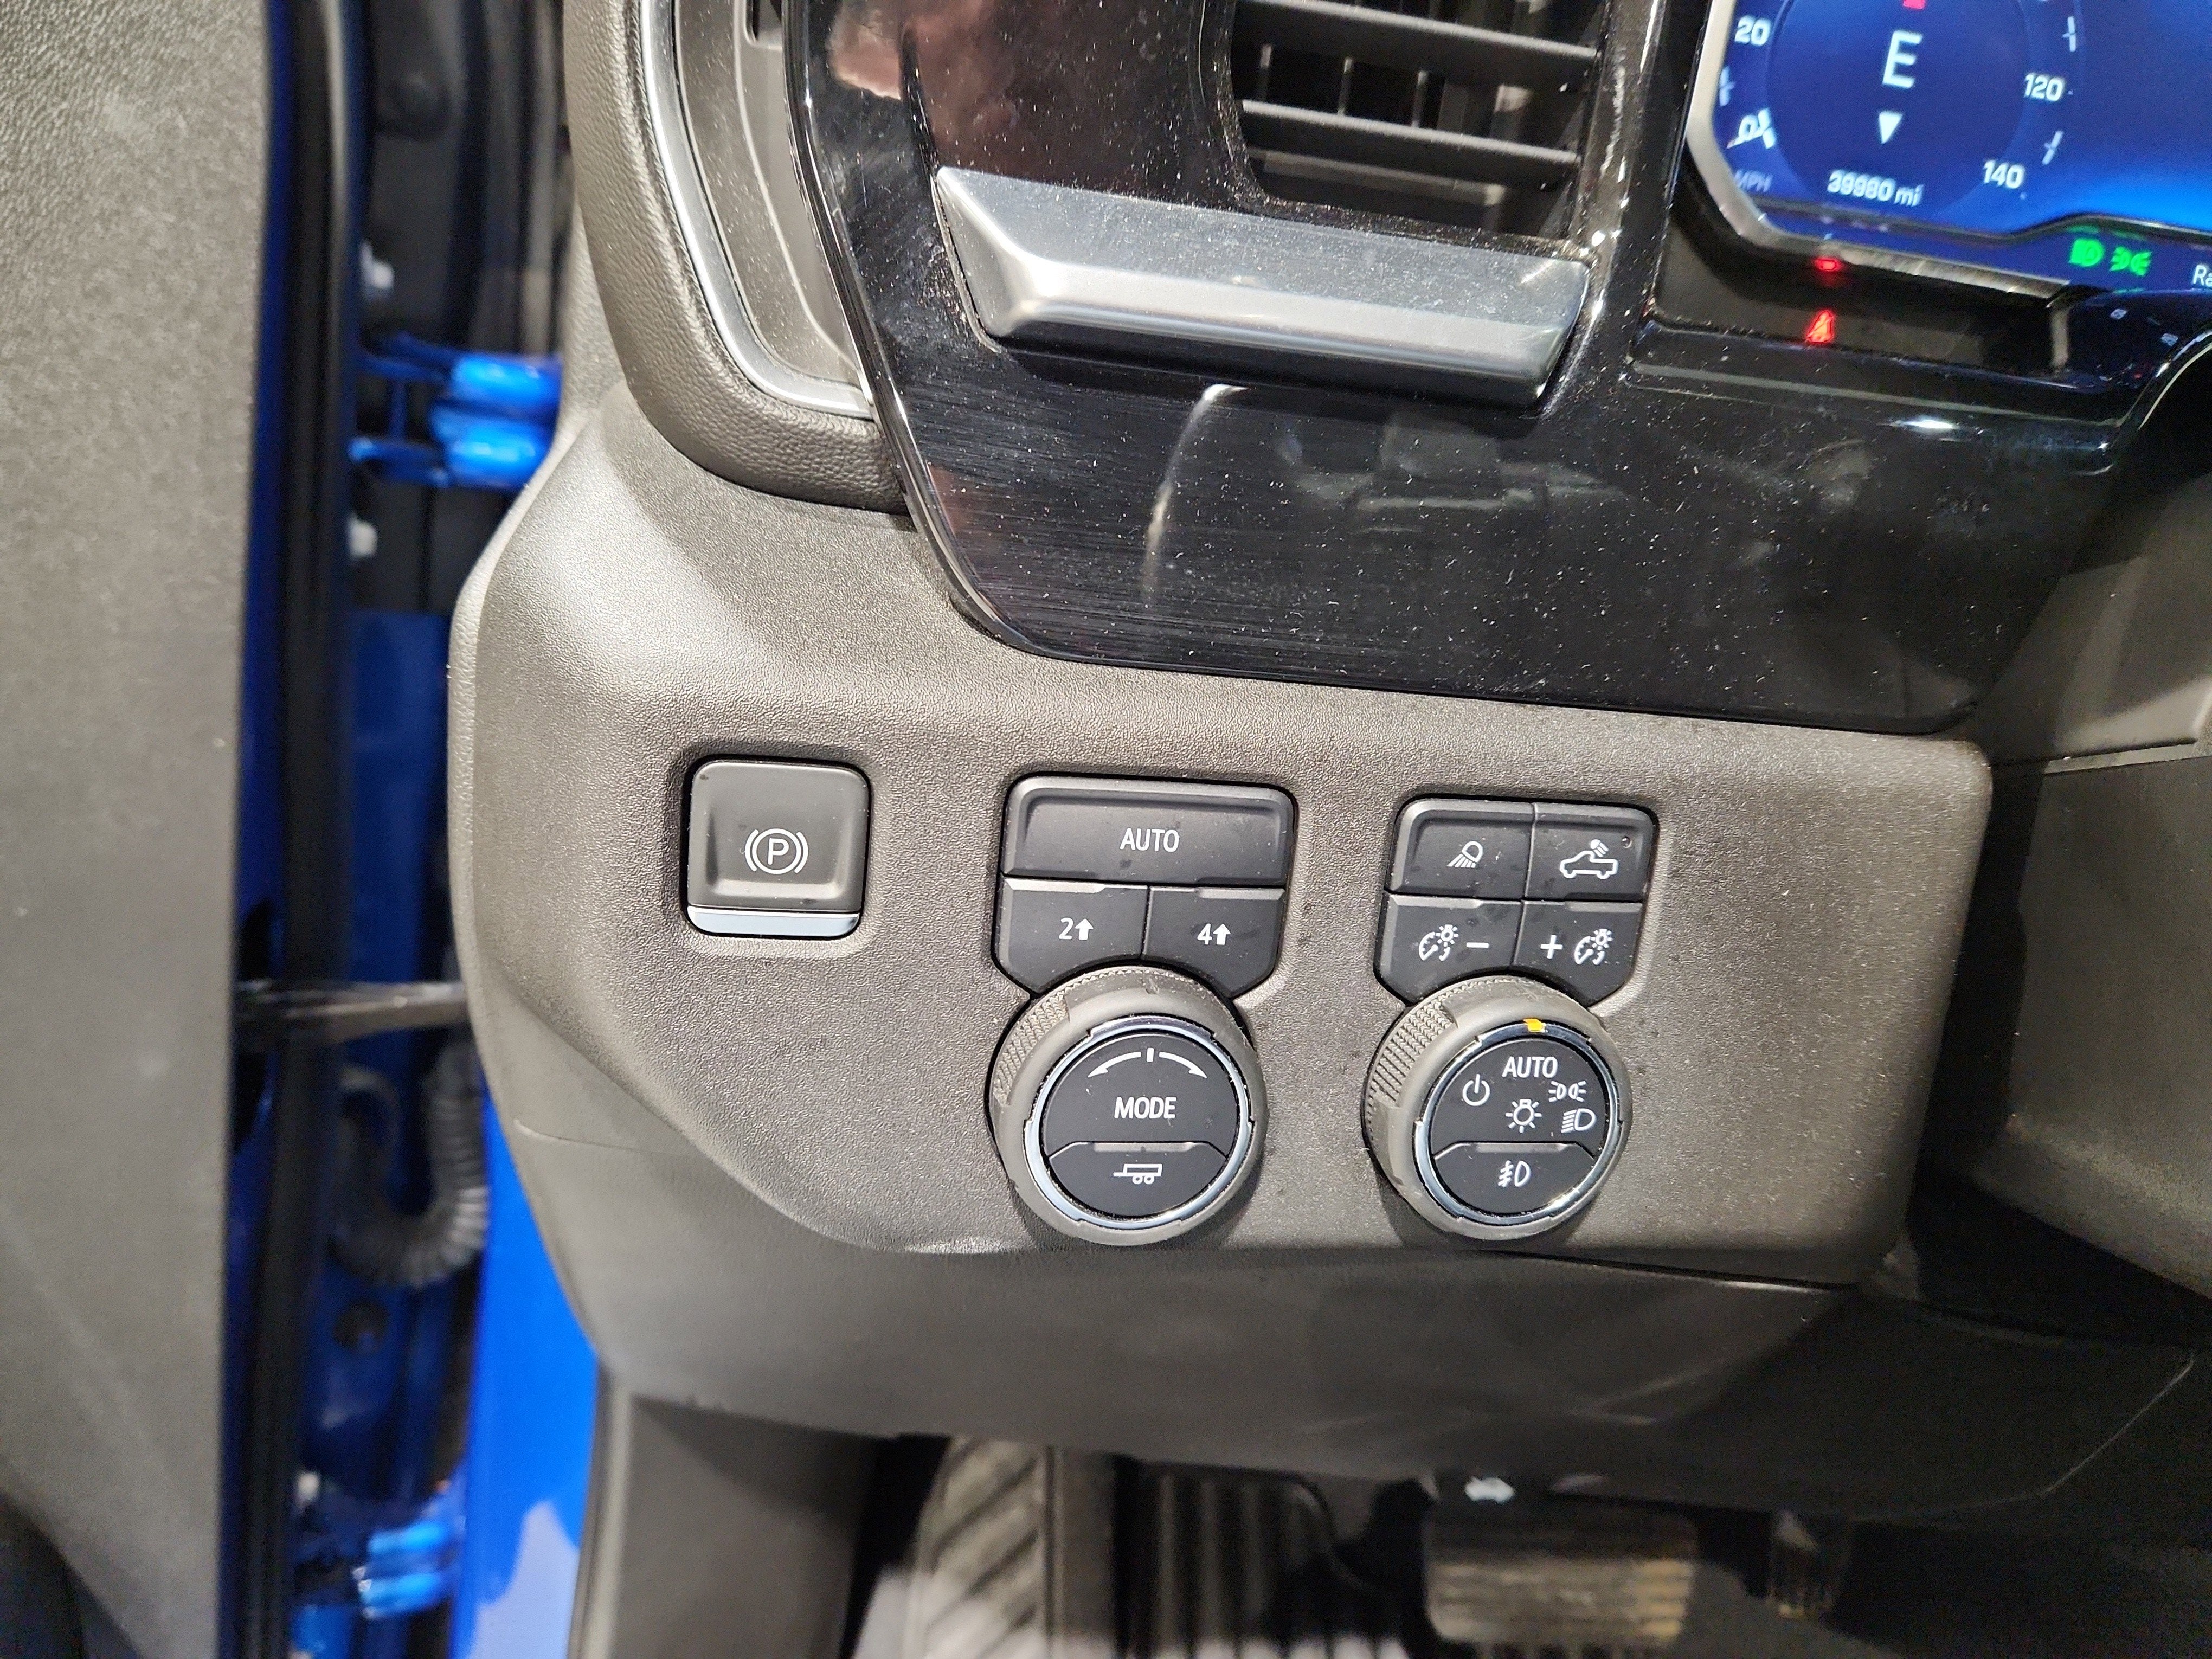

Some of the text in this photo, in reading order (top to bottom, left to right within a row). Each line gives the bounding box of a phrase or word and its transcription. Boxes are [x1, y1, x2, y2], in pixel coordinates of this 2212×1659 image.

[1735, 16, 1771, 46] 20
[1882, 30, 1922, 88] E
[2024, 73, 2065, 102] 120
[1983, 159, 2025, 189] 140
[1894, 184, 1924, 207] mi
[1120, 828, 1180, 852] AUTO
[1502, 1056, 1558, 1078] AUTO
[1114, 1097, 1176, 1119] MODE
